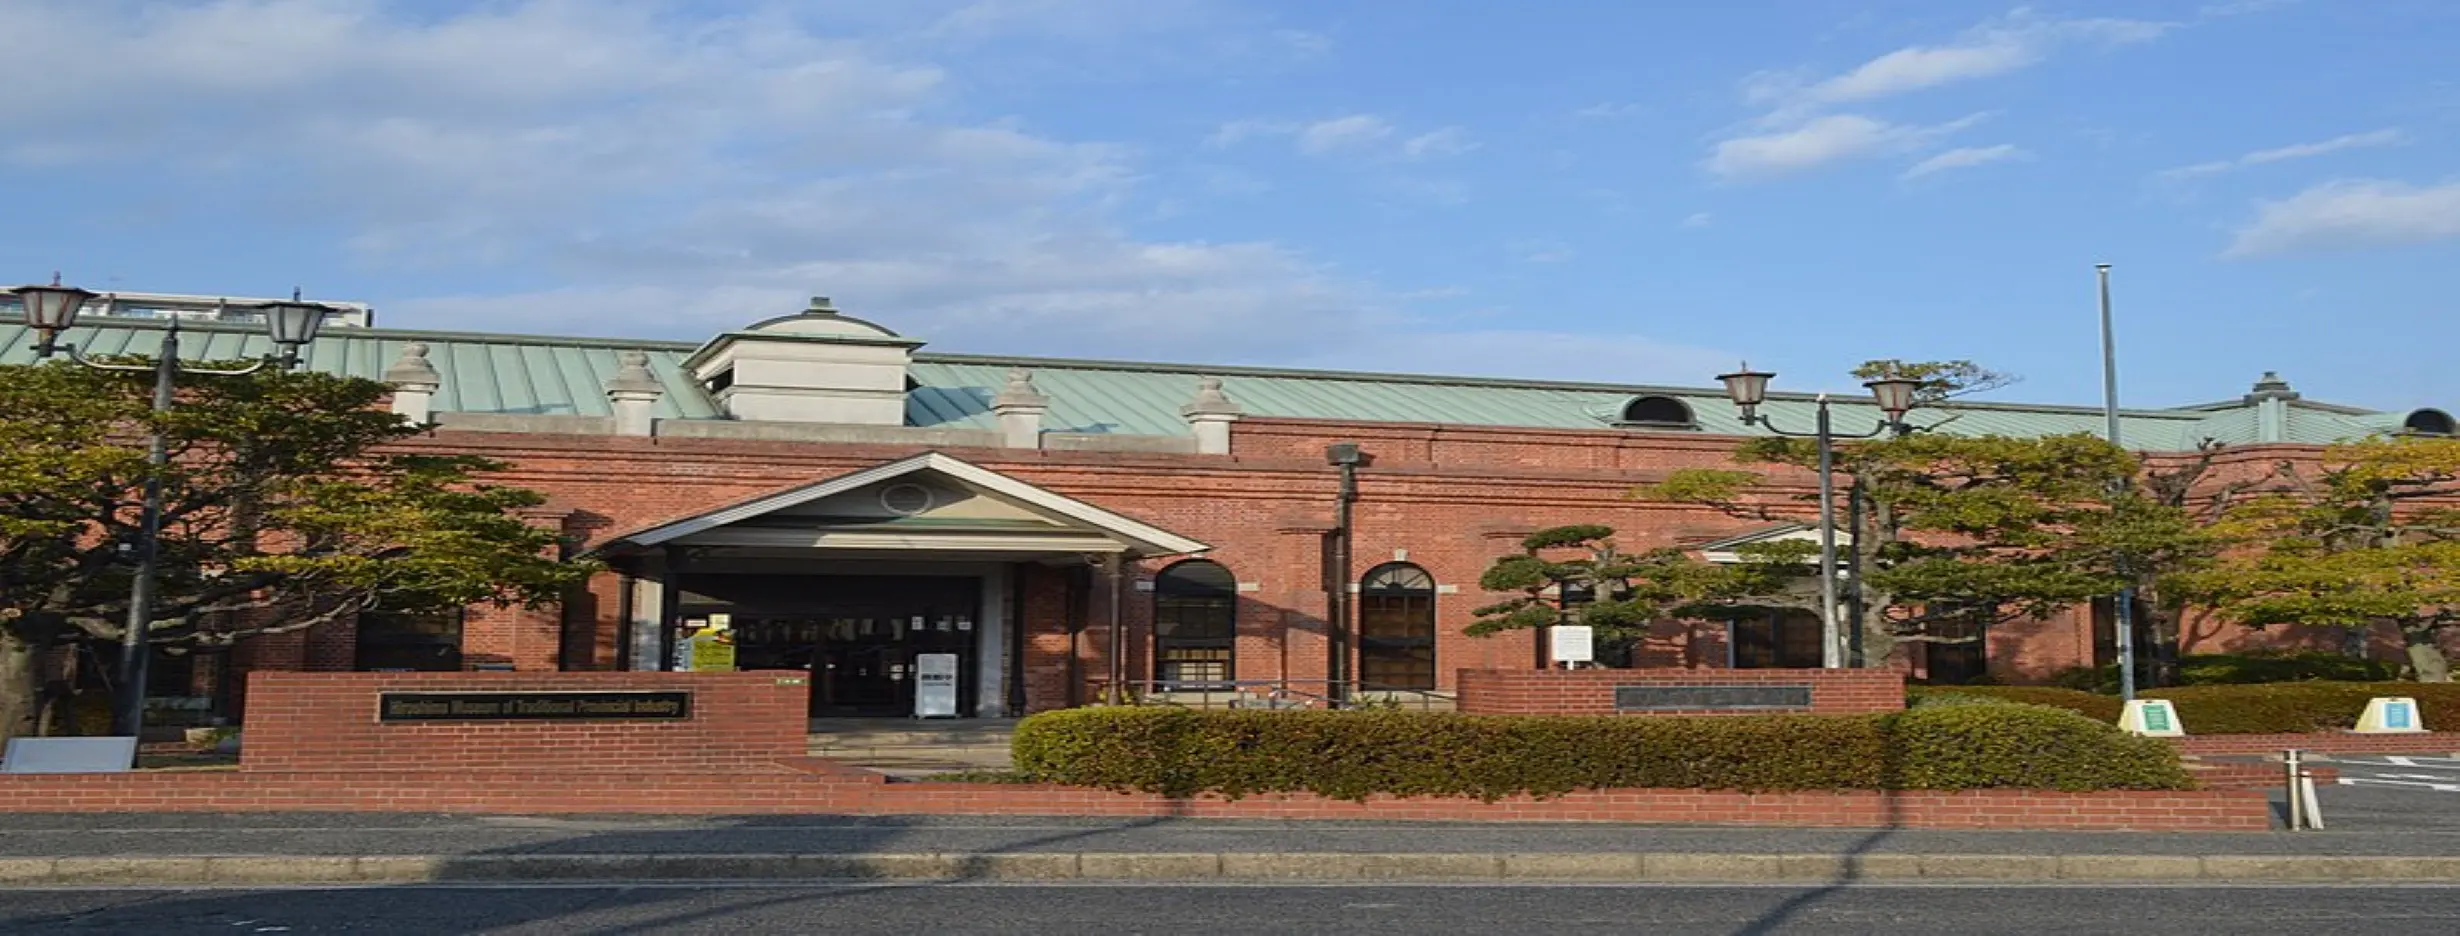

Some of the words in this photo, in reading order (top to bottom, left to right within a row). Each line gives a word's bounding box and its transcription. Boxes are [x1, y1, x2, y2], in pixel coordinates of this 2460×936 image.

[452, 700, 499, 714] Museum
[503, 701, 513, 713] of
[517, 700, 574, 713] Traditional
[577, 700, 629, 713] Provincial
[635, 700, 679, 715] Industry
